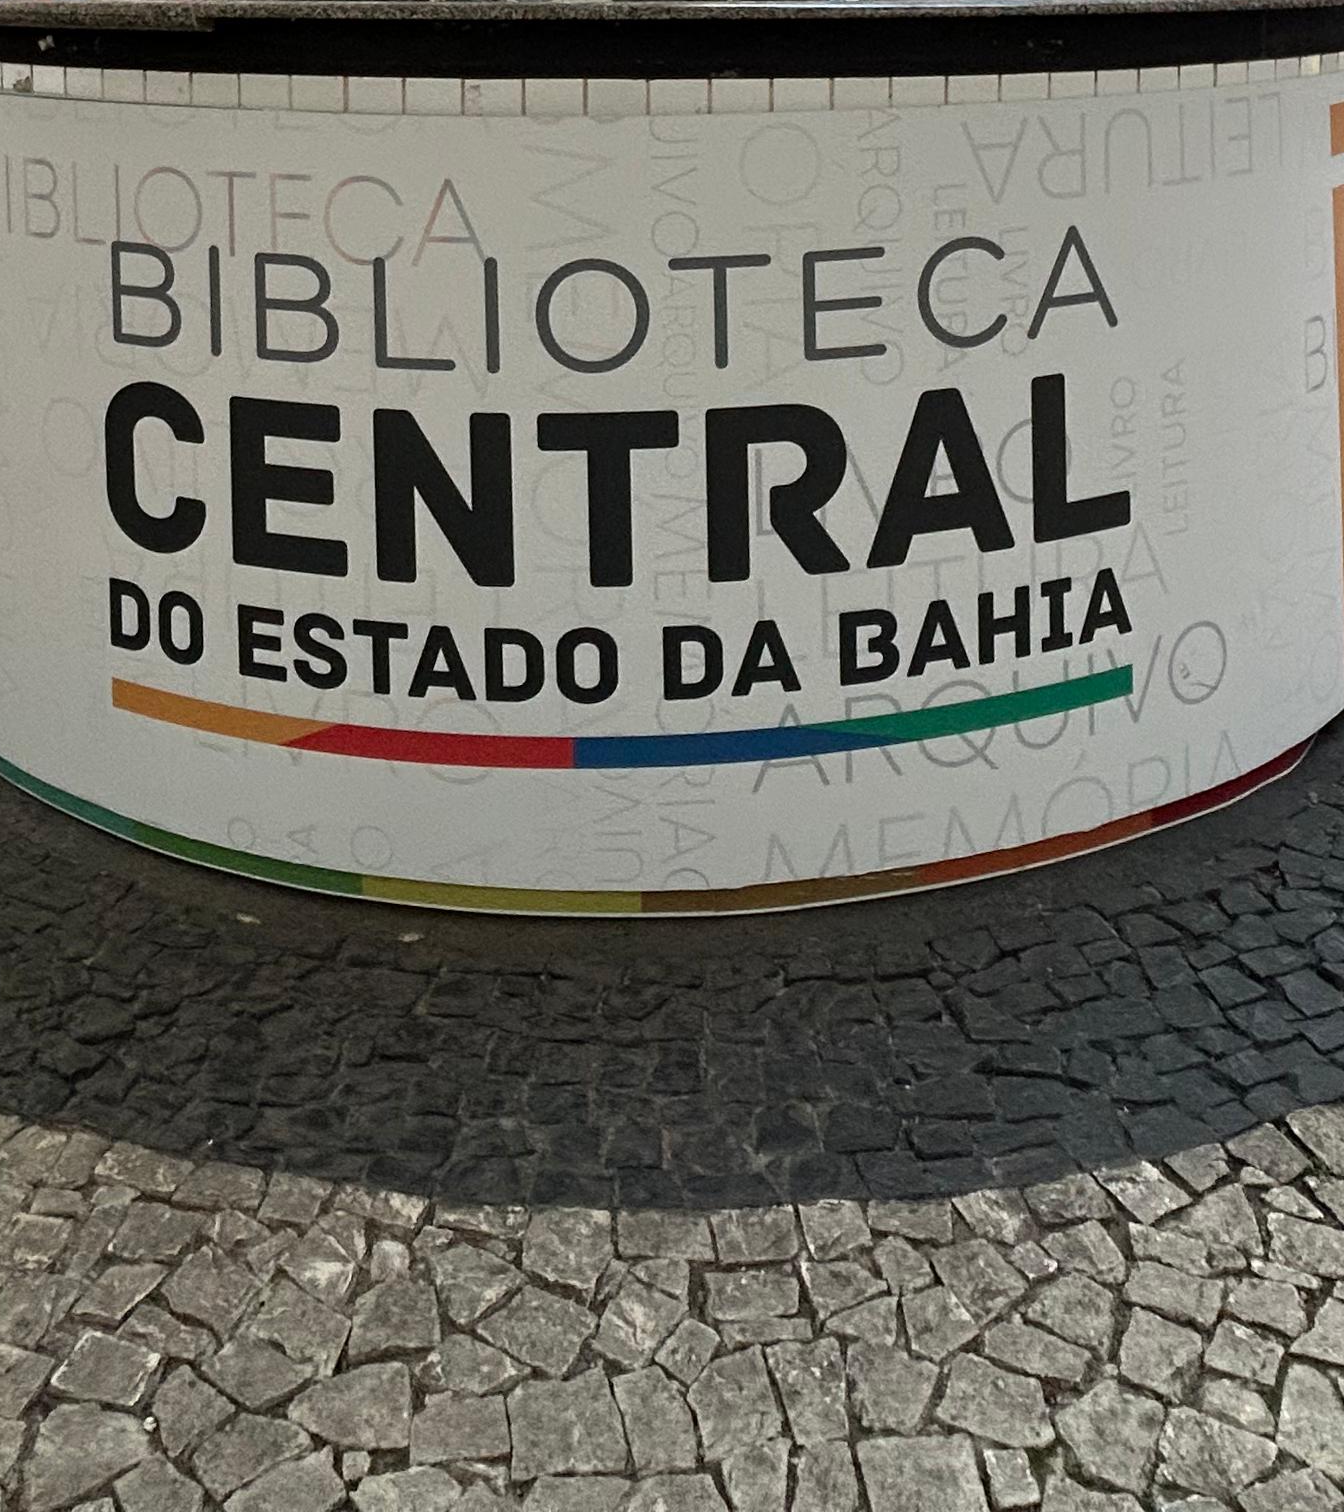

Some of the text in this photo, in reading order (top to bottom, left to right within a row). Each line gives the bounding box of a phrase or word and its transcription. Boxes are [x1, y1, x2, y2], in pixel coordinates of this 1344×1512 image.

[111, 225, 1118, 374] BIBLIOTECA
[104, 372, 1131, 588] CENTRAL
[108, 577, 204, 666] DO
[237, 603, 619, 705] ESTADO
[662, 619, 802, 701] DA
[838, 567, 1133, 687] BAHIA
